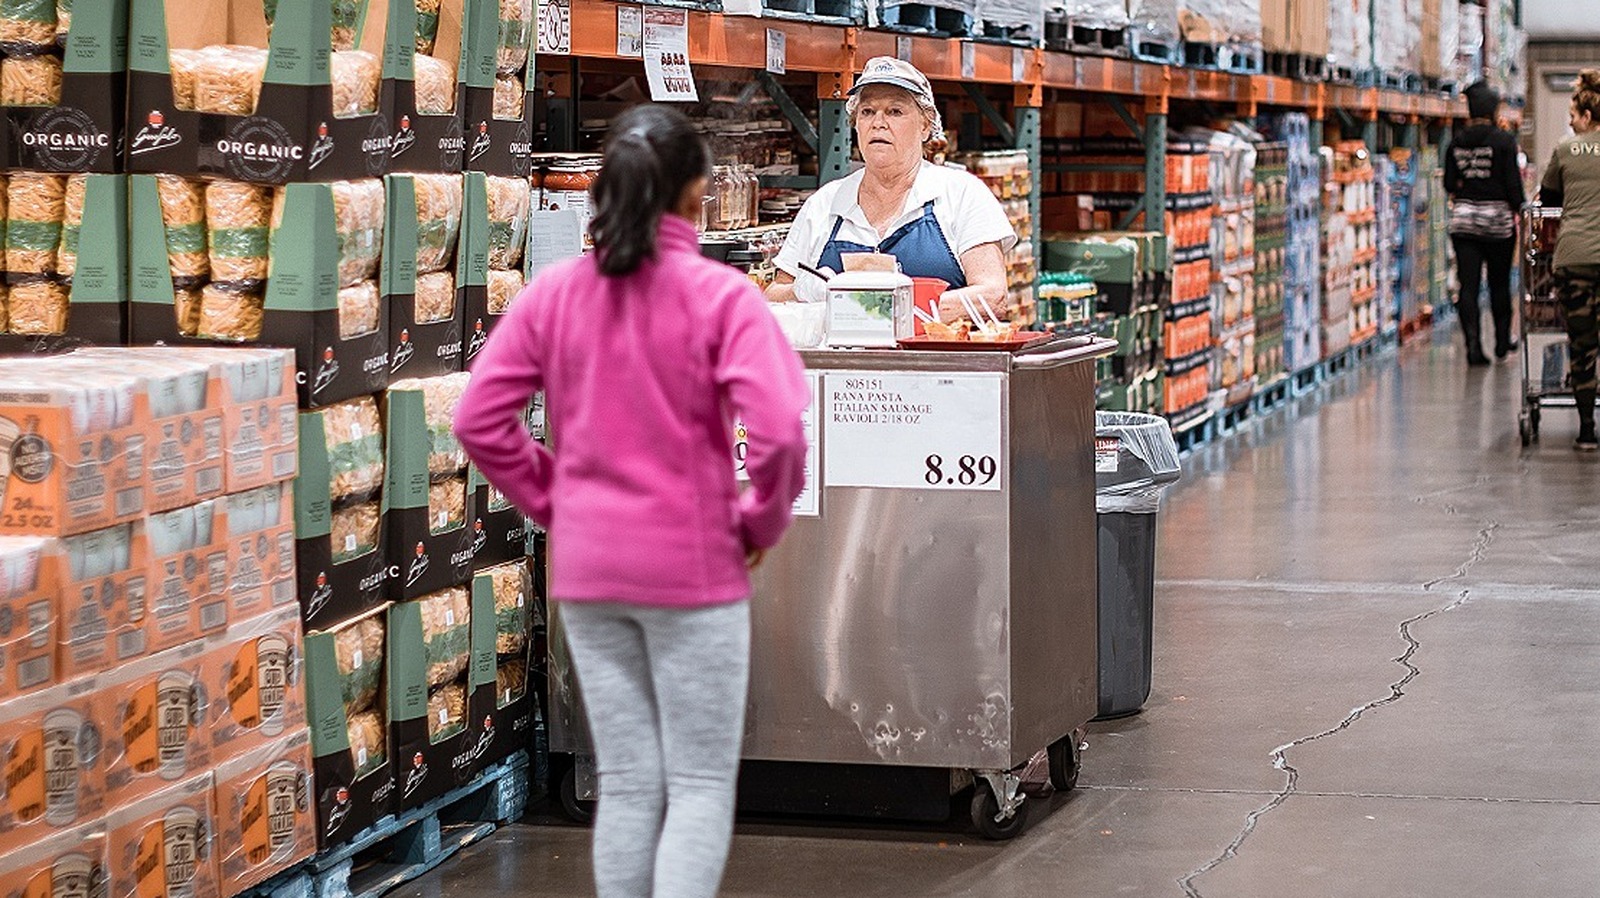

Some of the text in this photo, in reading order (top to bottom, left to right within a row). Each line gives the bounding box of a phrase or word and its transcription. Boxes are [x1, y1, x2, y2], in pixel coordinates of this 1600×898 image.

[23, 132, 109, 146] ORGANIC
[361, 135, 392, 152] ORGANIC
[217, 140, 303, 159] ORGANIC
[845, 379, 883, 390] 805151
[833, 391, 902, 402] RANA PASTA
[833, 403, 932, 414] ITALIAN SAUSAGE
[833, 413, 878, 424] RAVIOLI
[905, 414, 921, 425] OZ
[924, 453, 997, 486] 8.89
